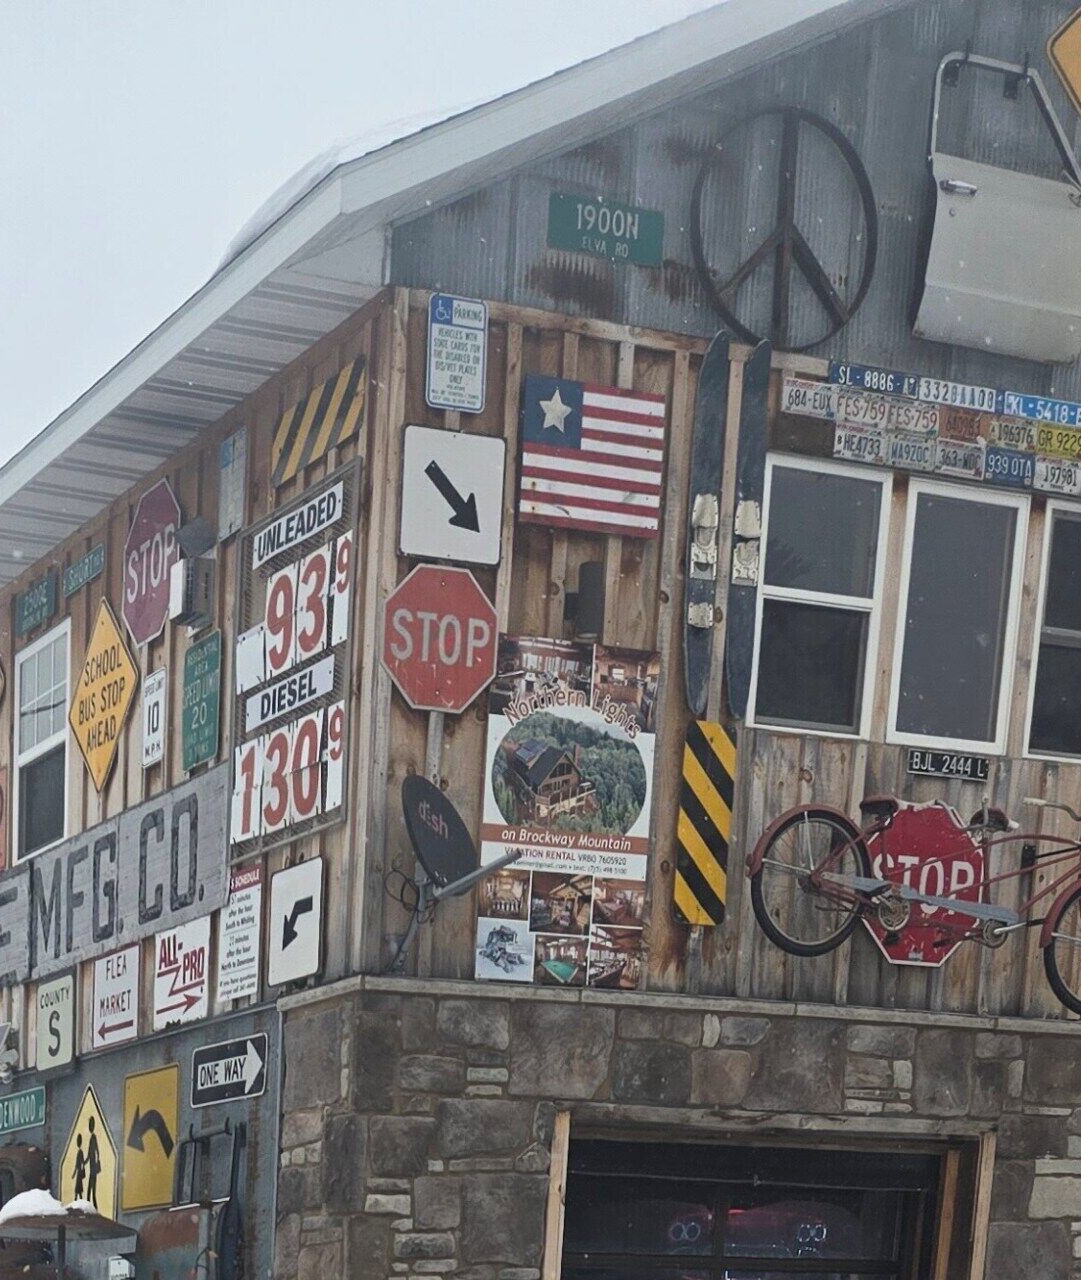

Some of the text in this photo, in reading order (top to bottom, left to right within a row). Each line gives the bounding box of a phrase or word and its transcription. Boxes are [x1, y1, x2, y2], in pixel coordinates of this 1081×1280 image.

[576, 202, 639, 240] 1900N
[615, 242, 629, 258] RD
[454, 307, 482, 322] PARKING
[988, 454, 1009, 474] 939
[257, 490, 337, 562] UNLEADED
[127, 522, 175, 604] STOP
[267, 553, 327, 671] 93
[390, 607, 490, 668] STOP
[84, 642, 122, 687] SCHOOL
[79, 676, 126, 726] BUS STOP
[260, 669, 317, 721] DIESEL
[502, 687, 641, 740] Northern Lights
[86, 714, 117, 754] AHEAD
[148, 700, 160, 736] 10
[192, 701, 207, 730] 20
[241, 718, 319, 835] 130
[912, 751, 936, 772] BJL
[941, 755, 972, 775] 2444
[138, 792, 205, 925] CO.
[502, 828, 631, 851] on Brockway Mountain
[505, 846, 544, 859] VAATION
[546, 850, 576, 861] RENTAL
[873, 852, 975, 915] STOP
[106, 954, 128, 981] FLEA
[183, 946, 205, 984] PRO
[39, 986, 70, 1010] COUNTY
[100, 989, 131, 1016] MARKET
[47, 1009, 61, 1057] S
[200, 1056, 247, 1088] ONE WAY
